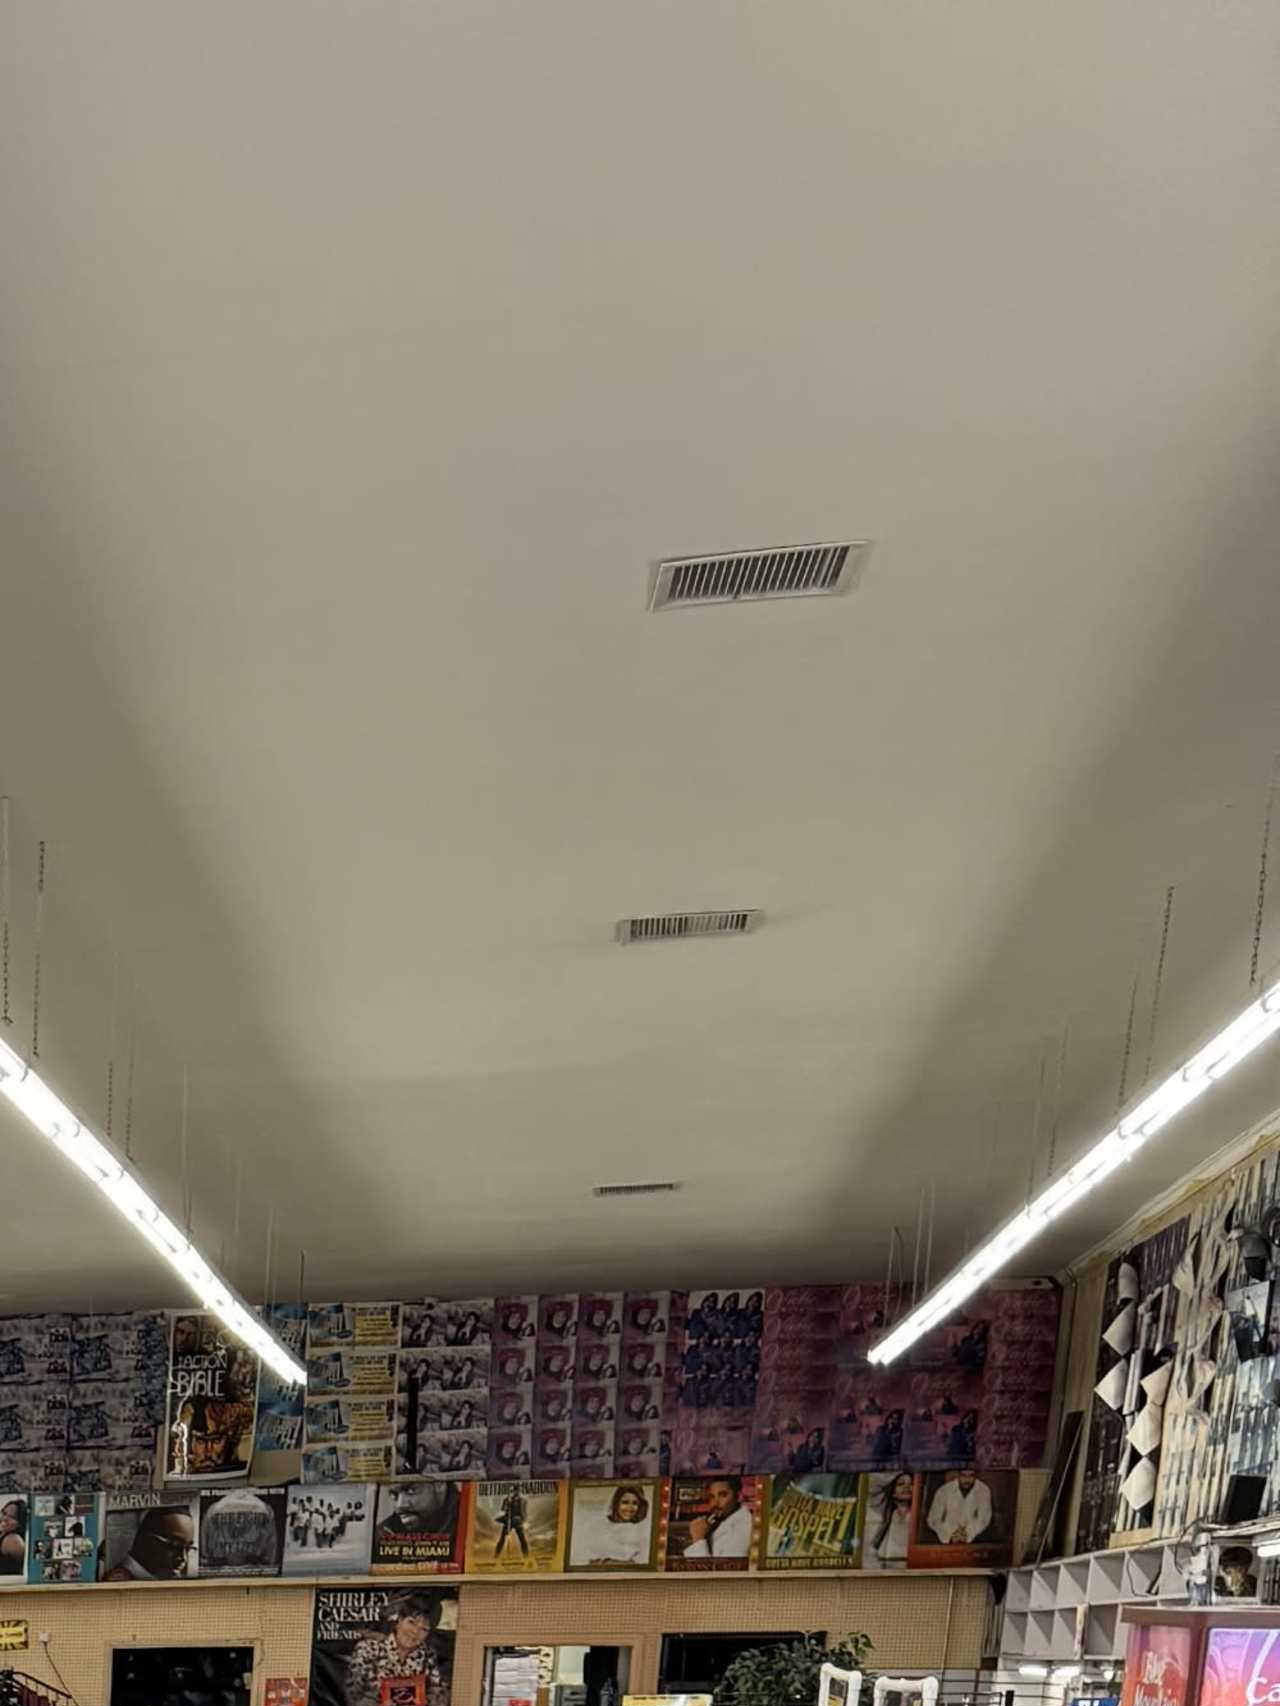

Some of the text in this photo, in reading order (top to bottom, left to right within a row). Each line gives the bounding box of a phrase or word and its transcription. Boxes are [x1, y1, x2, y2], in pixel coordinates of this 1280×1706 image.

[177, 1370, 226, 1397] BIBLE
[110, 1493, 160, 1508] MARVIN
[379, 1546, 450, 1556] LIVE MIAMI
[318, 1592, 390, 1608] SHIRLEY
[317, 1608, 381, 1622] CAESAR
